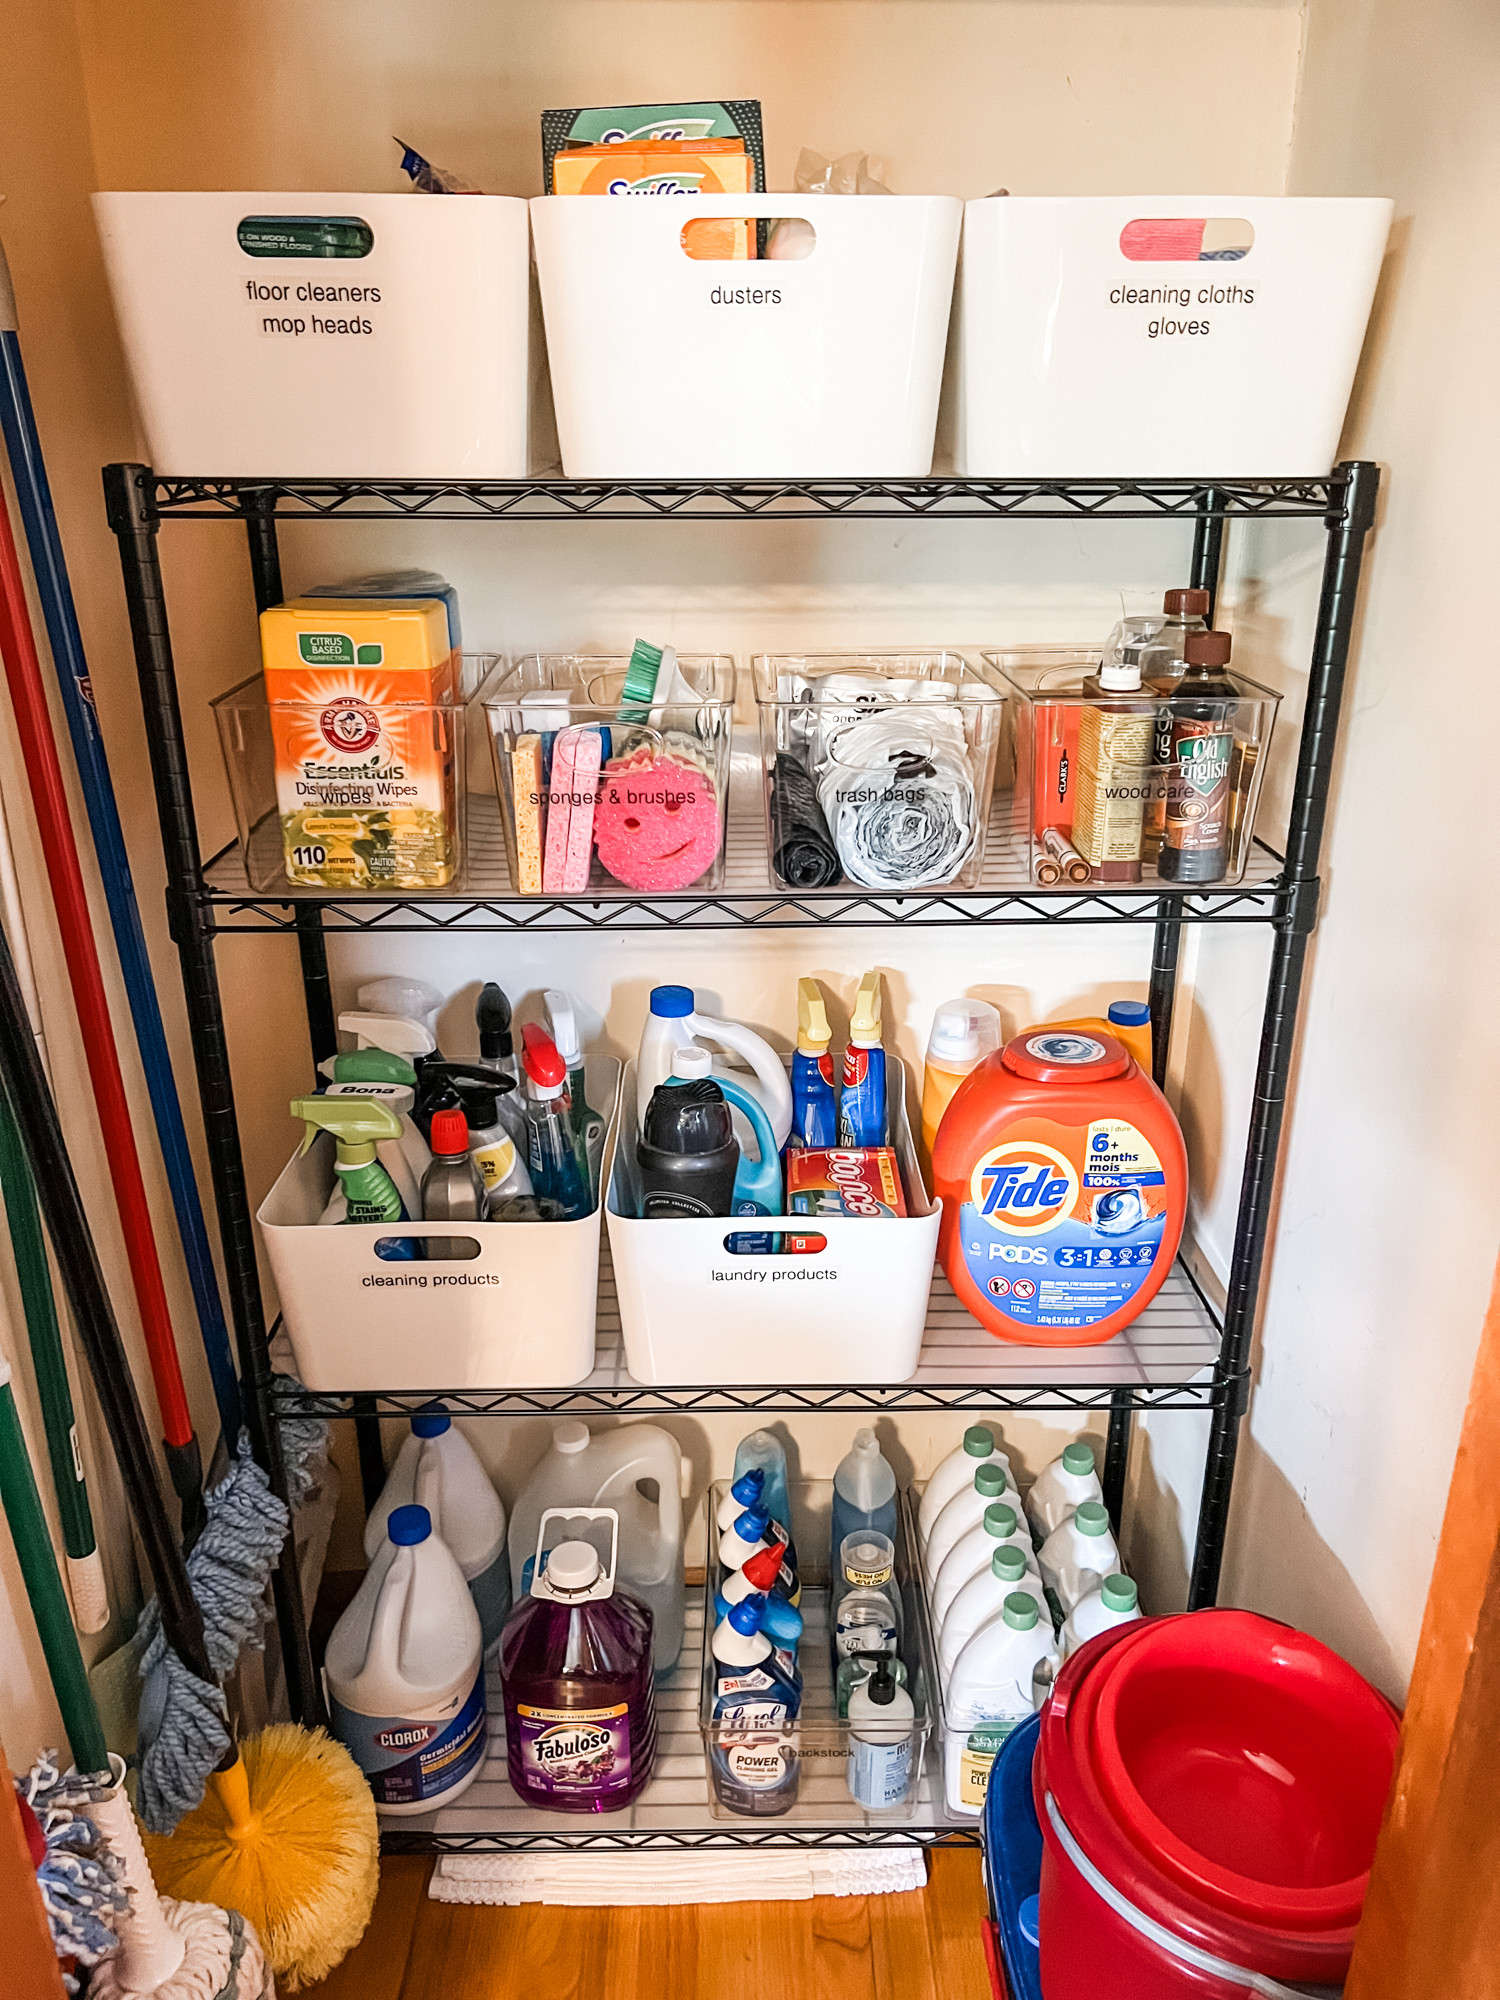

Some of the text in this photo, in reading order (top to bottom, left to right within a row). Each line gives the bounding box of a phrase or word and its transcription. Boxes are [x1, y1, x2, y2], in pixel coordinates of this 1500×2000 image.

[261, 234, 288, 242] WOOD
[246, 281, 382, 302] floor cleaners
[710, 285, 782, 305] dusters
[1109, 285, 1255, 307] cleaning cloths
[263, 314, 373, 336] mop heads
[1148, 316, 1211, 338] gloves
[310, 637, 343, 647] CITRUS
[306, 654, 350, 662] DISINFECTION
[312, 646, 343, 655] BASED
[1193, 738, 1218, 763] Old
[1058, 760, 1068, 793] CLARK'S
[1180, 755, 1228, 785] English
[295, 782, 418, 798] Disinfecting Wipes
[529, 789, 696, 805] sponges & brushes
[835, 787, 925, 803] trash bags
[1105, 784, 1195, 799] wood care
[320, 792, 372, 807] wipes
[293, 846, 326, 865] 110
[340, 1086, 396, 1094] Bona
[1090, 1152, 1139, 1162] months
[1089, 1162, 1120, 1172] mois
[828, 1150, 881, 1216] bounce
[1087, 1176, 1121, 1187] 100%
[981, 1166, 1069, 1215] Tide
[355, 1205, 387, 1214] STAINS
[988, 1242, 1048, 1266] PODS
[362, 1273, 500, 1288] cleaning products
[711, 1268, 837, 1282] laundry products
[380, 1726, 429, 1746] CLOROX
[533, 1730, 611, 1762] Fabuloso
[789, 1747, 855, 1758] backstock
[736, 1755, 779, 1766] POWER
[970, 1775, 987, 1786] CLE
